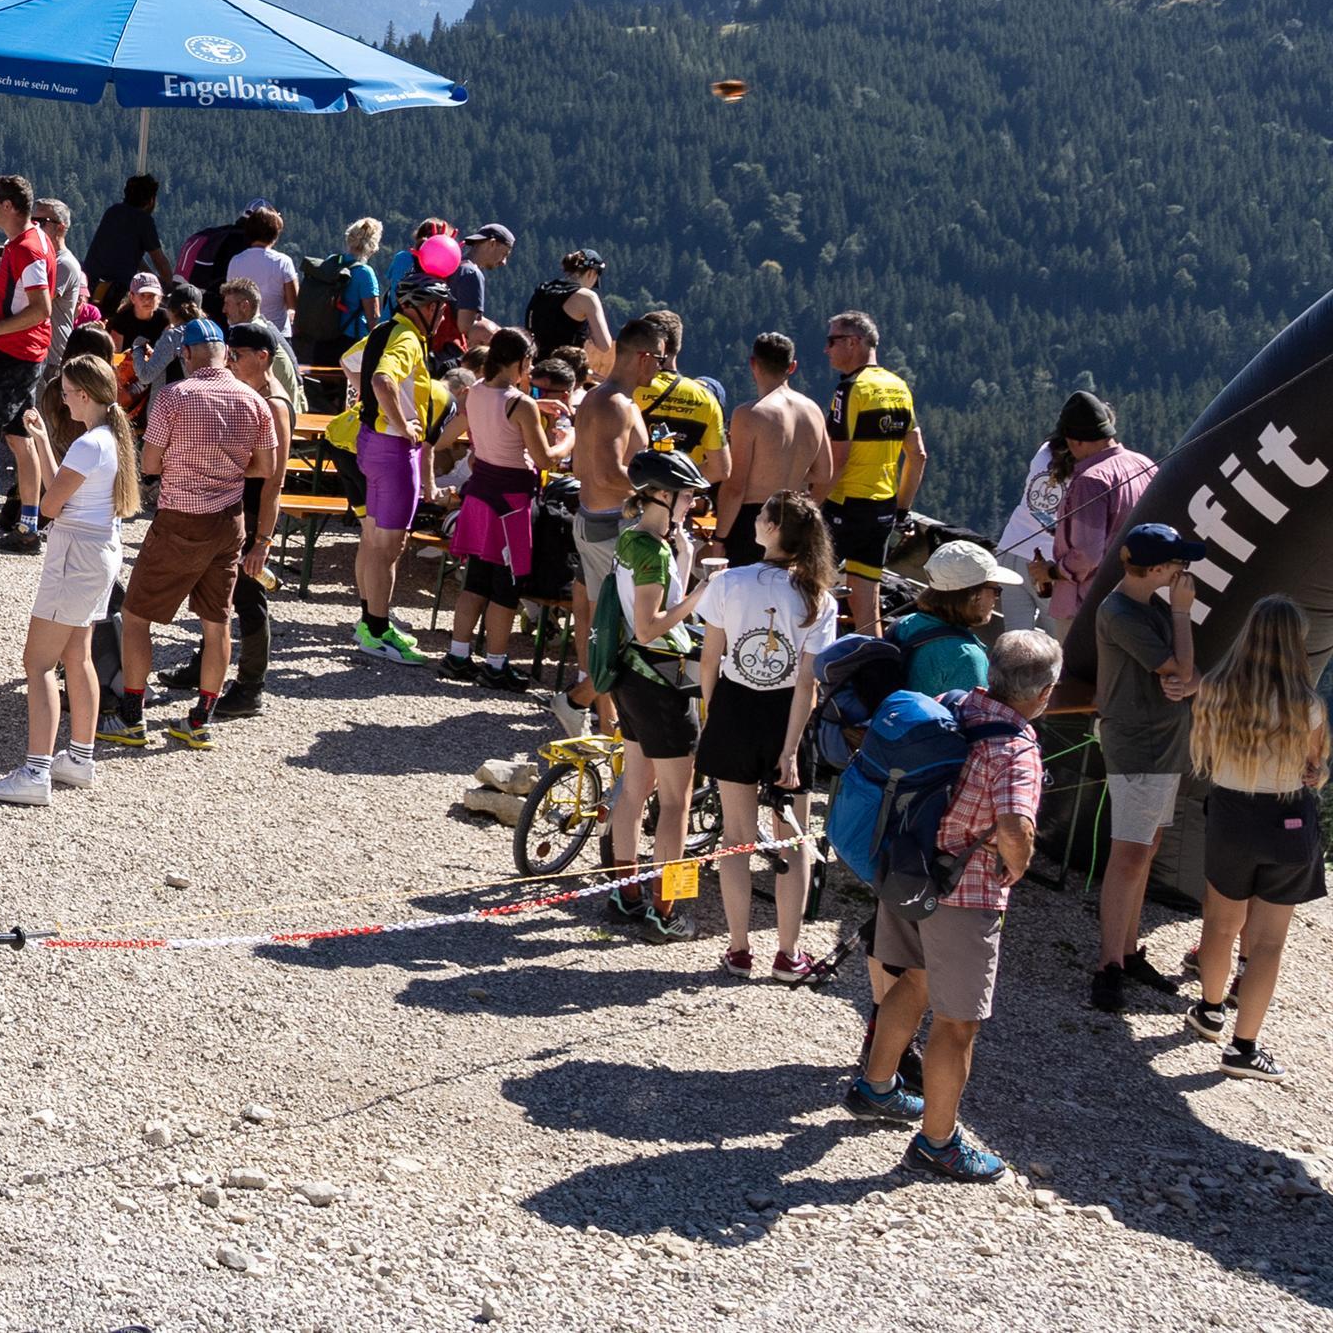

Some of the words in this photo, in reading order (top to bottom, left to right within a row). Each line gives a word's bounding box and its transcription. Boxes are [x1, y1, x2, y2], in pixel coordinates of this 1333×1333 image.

[14, 77, 30, 88] wie
[31, 79, 50, 90] sein
[52, 82, 78, 95] Name
[164, 74, 299, 105] Engelbräu
